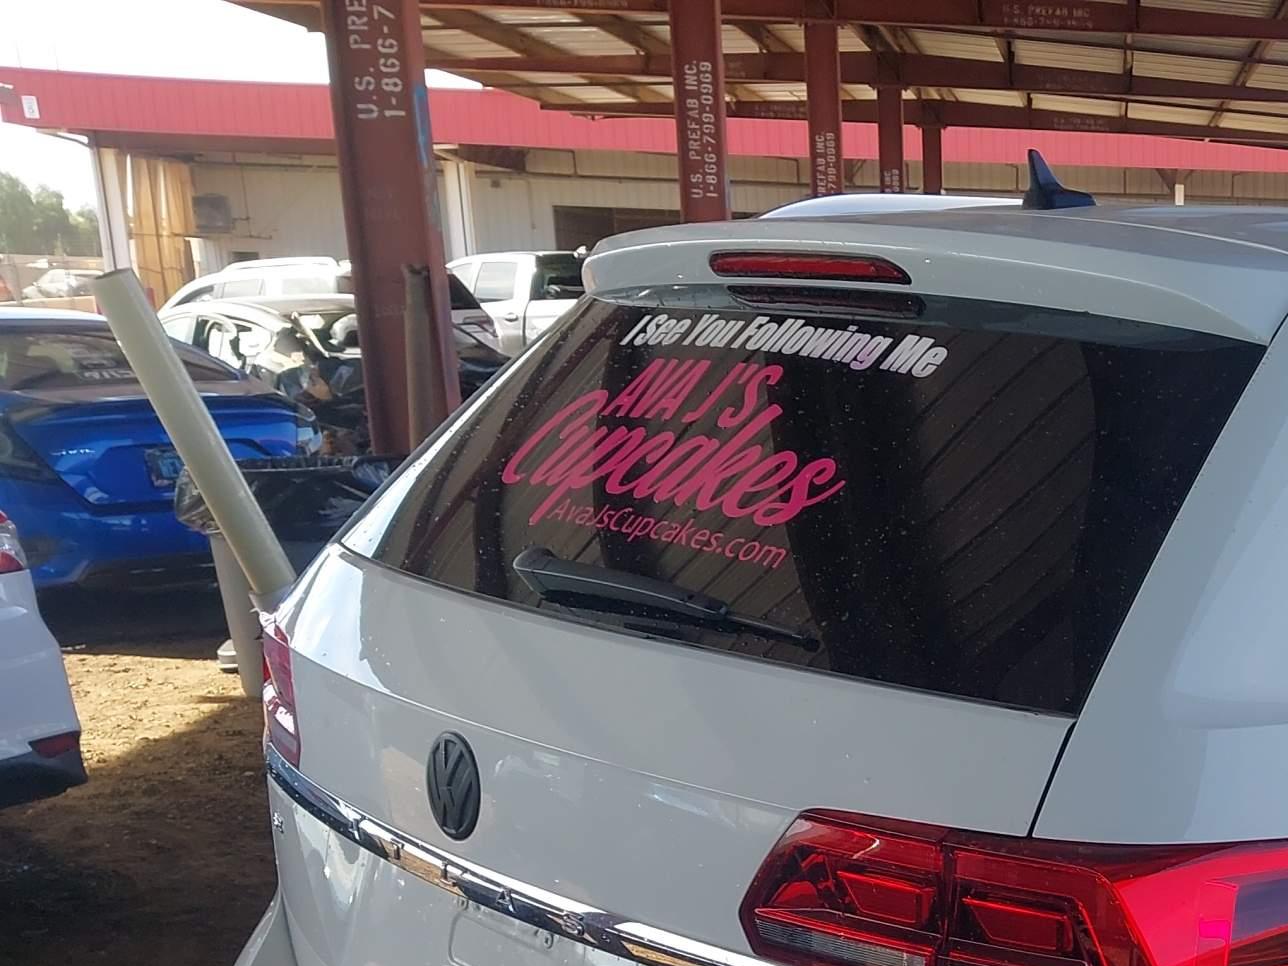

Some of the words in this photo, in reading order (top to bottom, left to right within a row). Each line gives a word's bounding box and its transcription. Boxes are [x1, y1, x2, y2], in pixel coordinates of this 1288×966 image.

[354, 67, 379, 119] U.S.
[684, 60, 698, 90] INC.
[686, 99, 701, 160] PREFAB
[700, 61, 719, 198] 1-866-799-0969
[690, 169, 704, 198] U.S.
[619, 315, 650, 345] I
[638, 314, 692, 346] See
[682, 314, 745, 348] You
[731, 316, 893, 370] Following
[880, 334, 948, 378] Me
[601, 358, 711, 420] AVA
[682, 361, 784, 428] J'S
[501, 389, 846, 527] Cupcakes
[548, 499, 788, 569] AvaJsCupcakes.com
